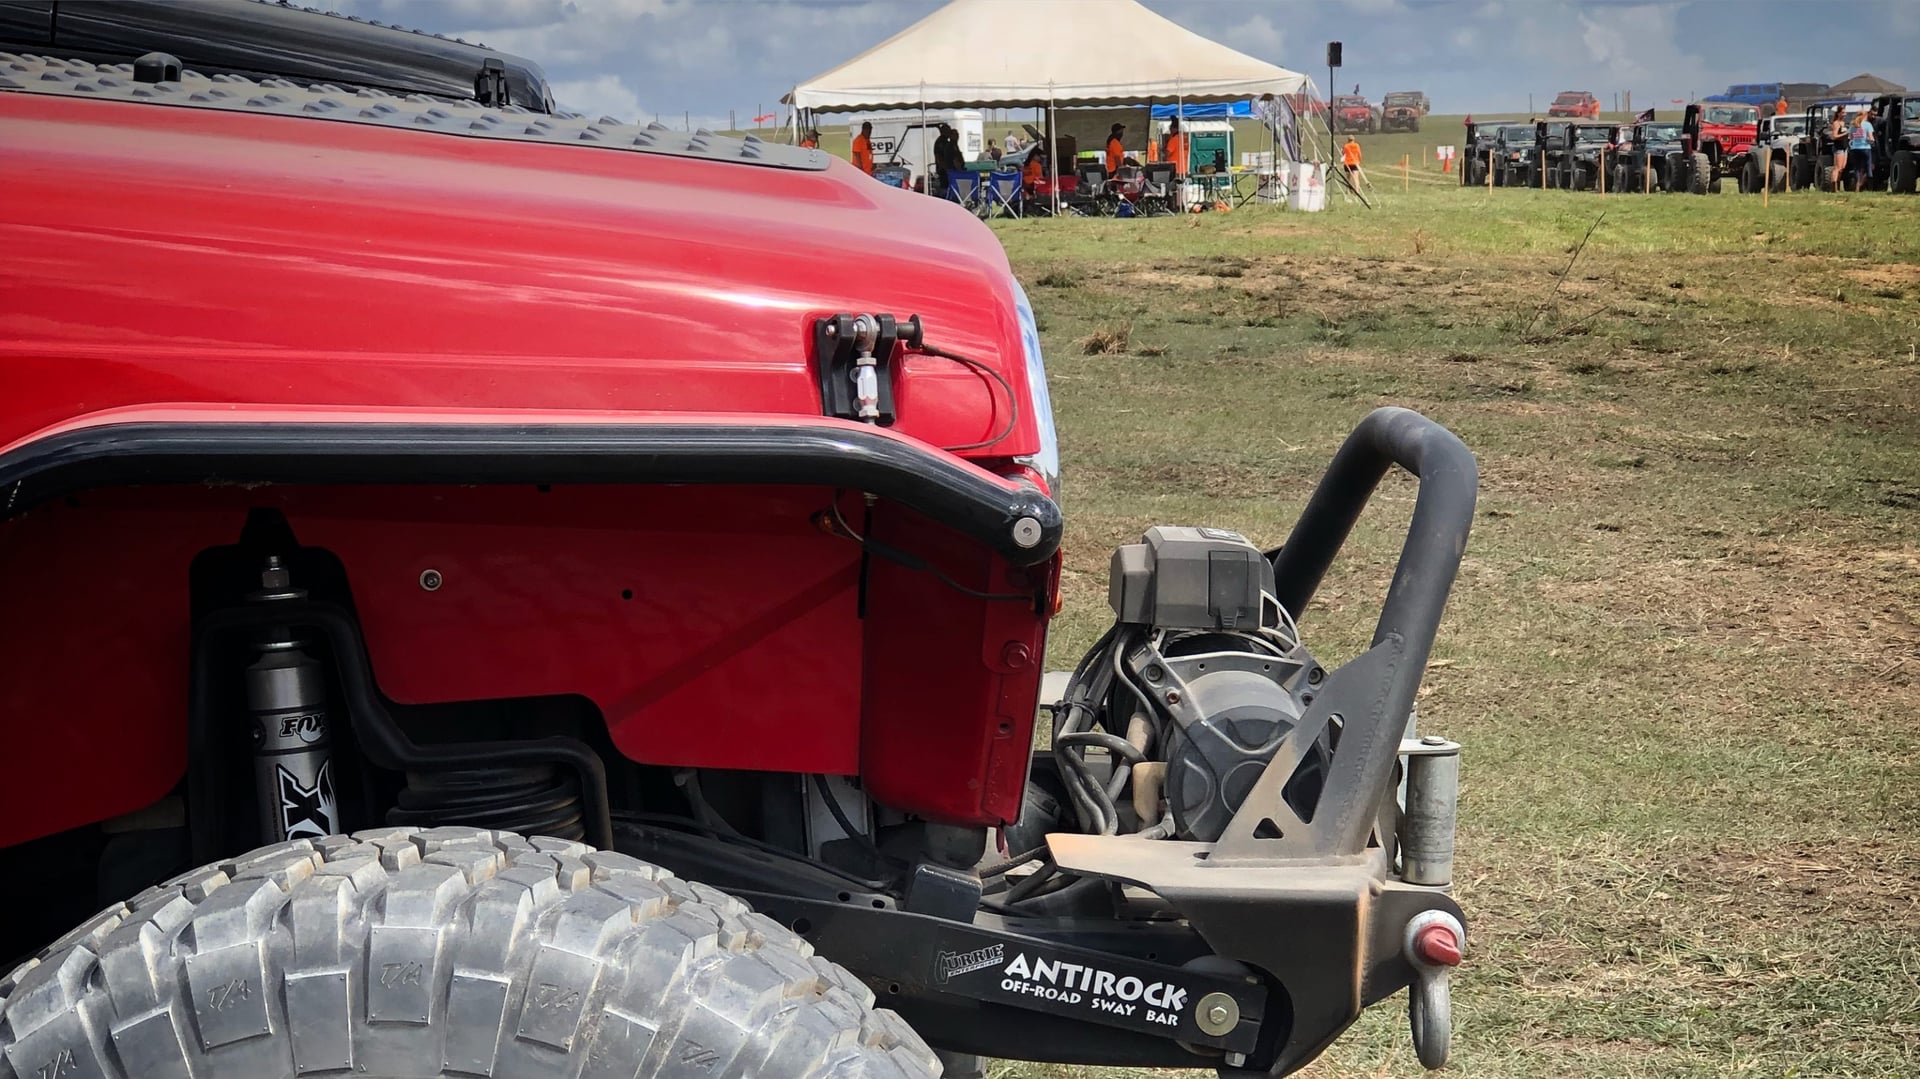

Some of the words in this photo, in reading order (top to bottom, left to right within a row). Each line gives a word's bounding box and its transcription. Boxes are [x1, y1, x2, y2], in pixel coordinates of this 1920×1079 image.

[870, 140, 893, 151] eep
[279, 713, 327, 743] FOX
[380, 961, 424, 989] T/A
[934, 943, 1004, 984] CURRIE
[1001, 978, 1081, 1005] OFF-ROAD
[1091, 997, 1137, 1018] SWAY
[1146, 1010, 1179, 1027] BAR
